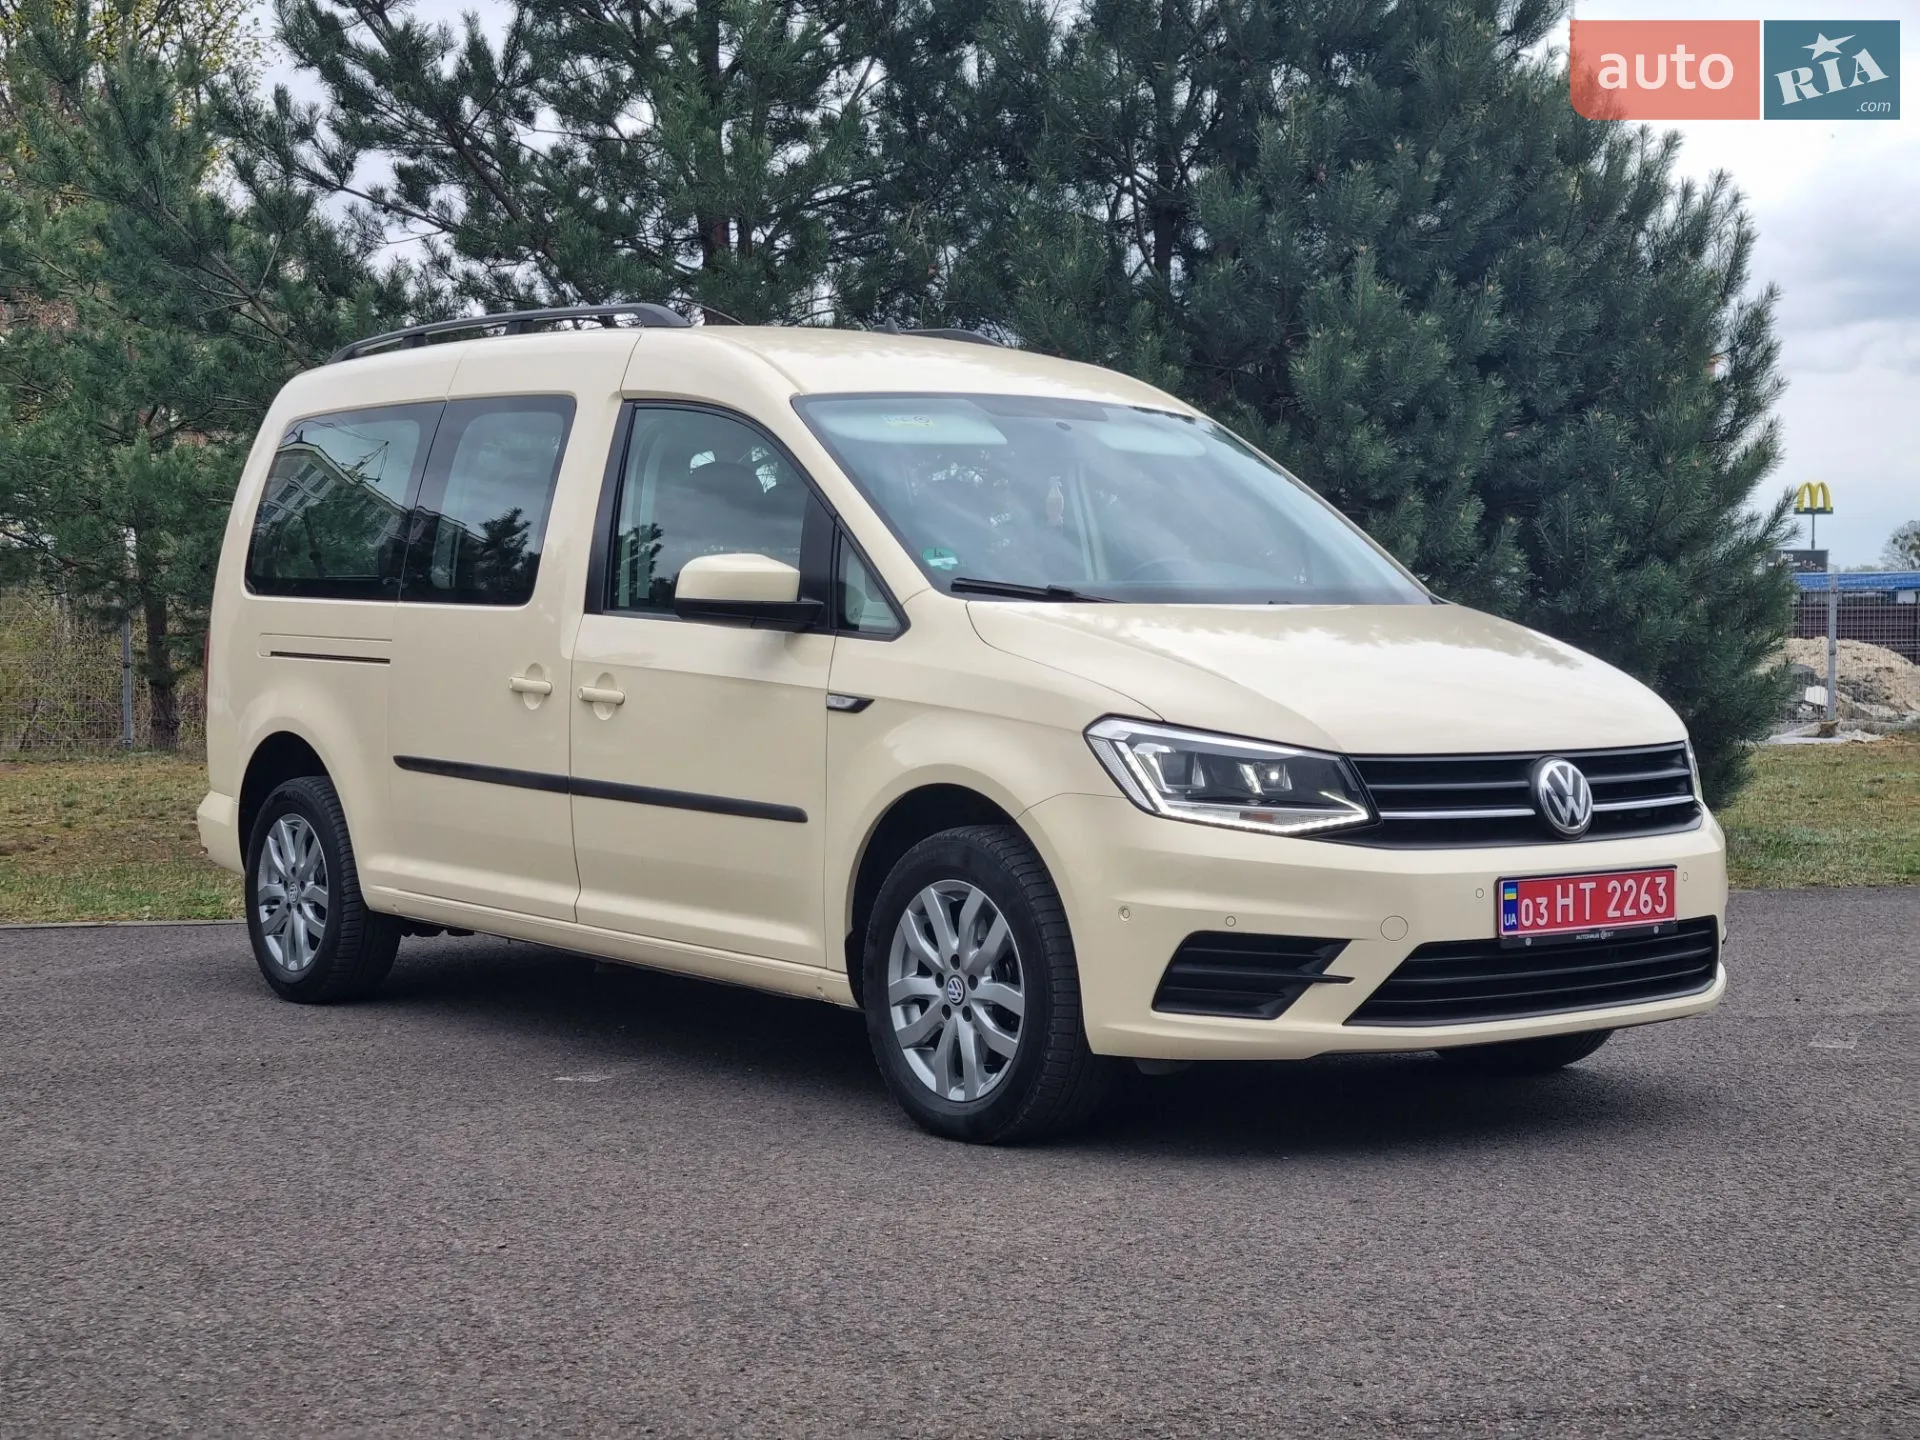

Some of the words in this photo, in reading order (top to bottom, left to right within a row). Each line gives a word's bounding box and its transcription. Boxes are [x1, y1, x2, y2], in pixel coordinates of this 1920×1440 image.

[1521, 896, 1548, 927] 03
[1556, 882, 1597, 923] HT
[1607, 876, 1668, 918] 2263
[1504, 913, 1517, 926] UA
